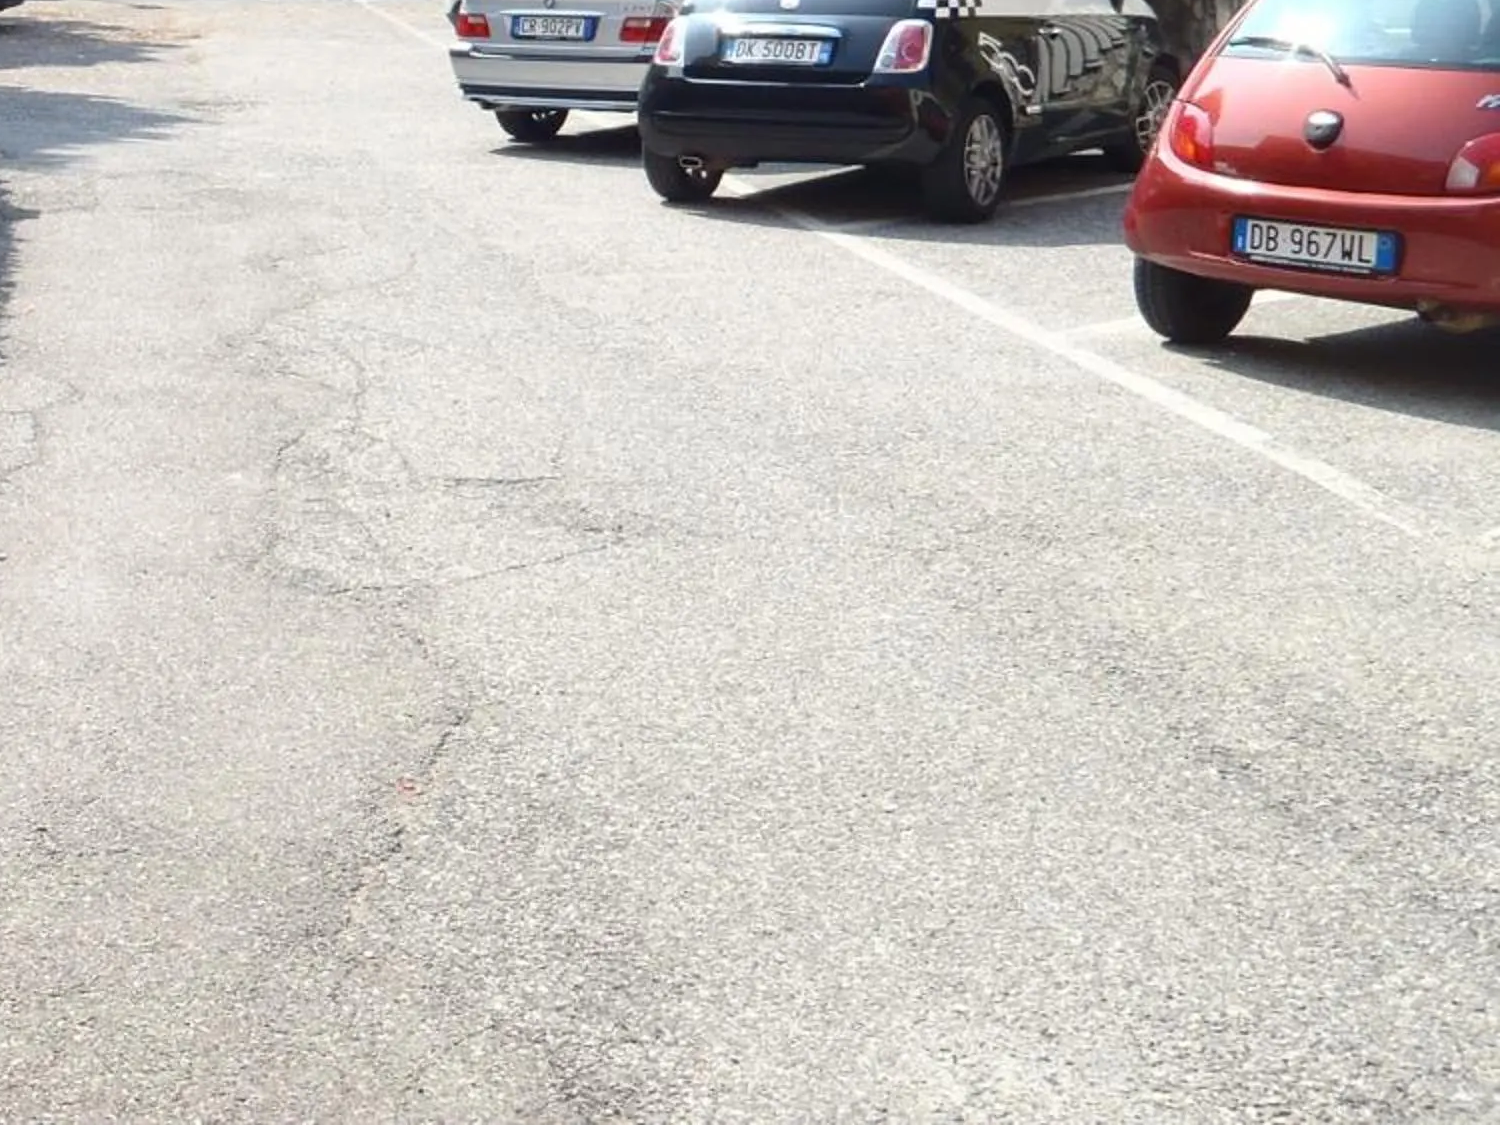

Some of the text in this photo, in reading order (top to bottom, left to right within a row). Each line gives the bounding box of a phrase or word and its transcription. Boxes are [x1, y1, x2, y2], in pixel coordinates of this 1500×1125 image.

[736, 40, 818, 60] DK 500BT
[1250, 223, 1279, 252] DB
[1290, 228, 1372, 264] 967WL
